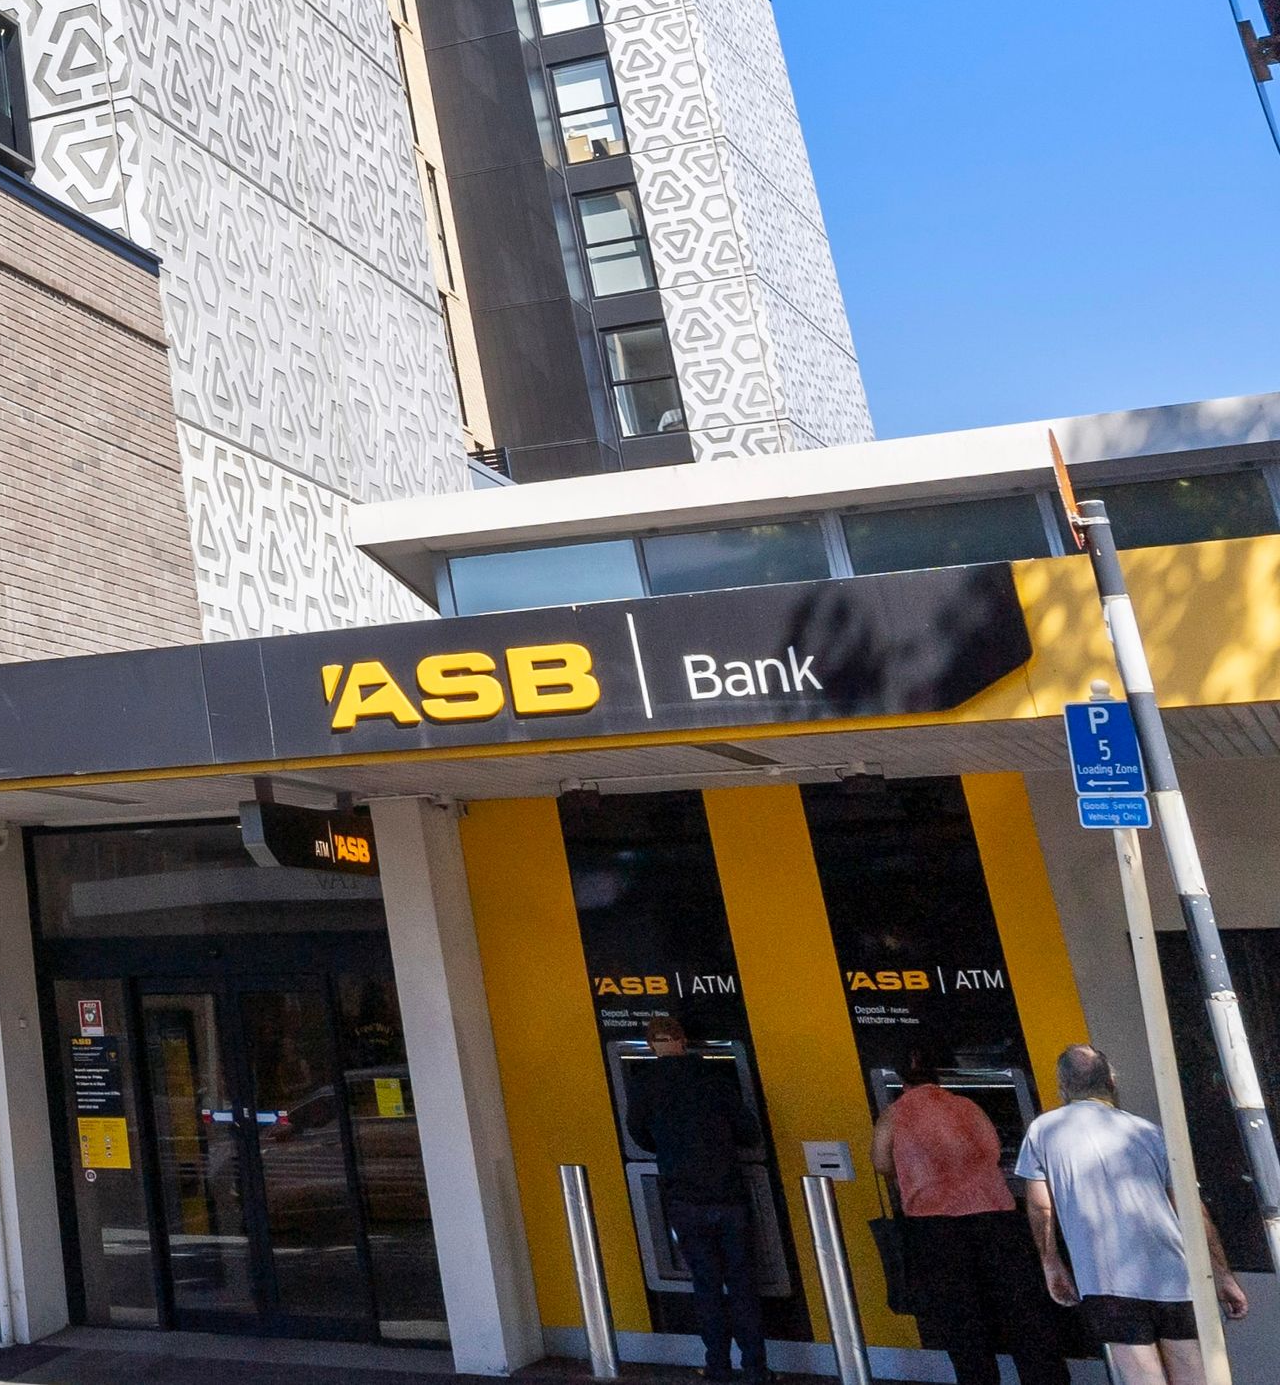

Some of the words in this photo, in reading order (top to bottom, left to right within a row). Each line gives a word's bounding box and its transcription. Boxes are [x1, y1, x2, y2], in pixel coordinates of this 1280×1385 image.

[321, 643, 600, 729] ASB
[683, 645, 823, 700] Bank
[1087, 707, 1109, 735] P
[1098, 740, 1111, 761] 5
[1077, 764, 1113, 776] Loading
[1115, 763, 1139, 775] Zone
[1082, 800, 1110, 811] Goods
[1112, 800, 1143, 810] Service
[1122, 811, 1141, 822] Only
[315, 839, 330, 858] ATM
[334, 834, 371, 863] ASB
[594, 976, 670, 996] ASB
[691, 975, 737, 994] ATM
[846, 970, 930, 991] ASB
[955, 969, 1005, 990] ATM
[600, 1009, 630, 1018] Deposit
[854, 1005, 887, 1015] Deposit
[603, 1019, 638, 1027] Withdraw
[857, 1016, 896, 1025] Withdraw
